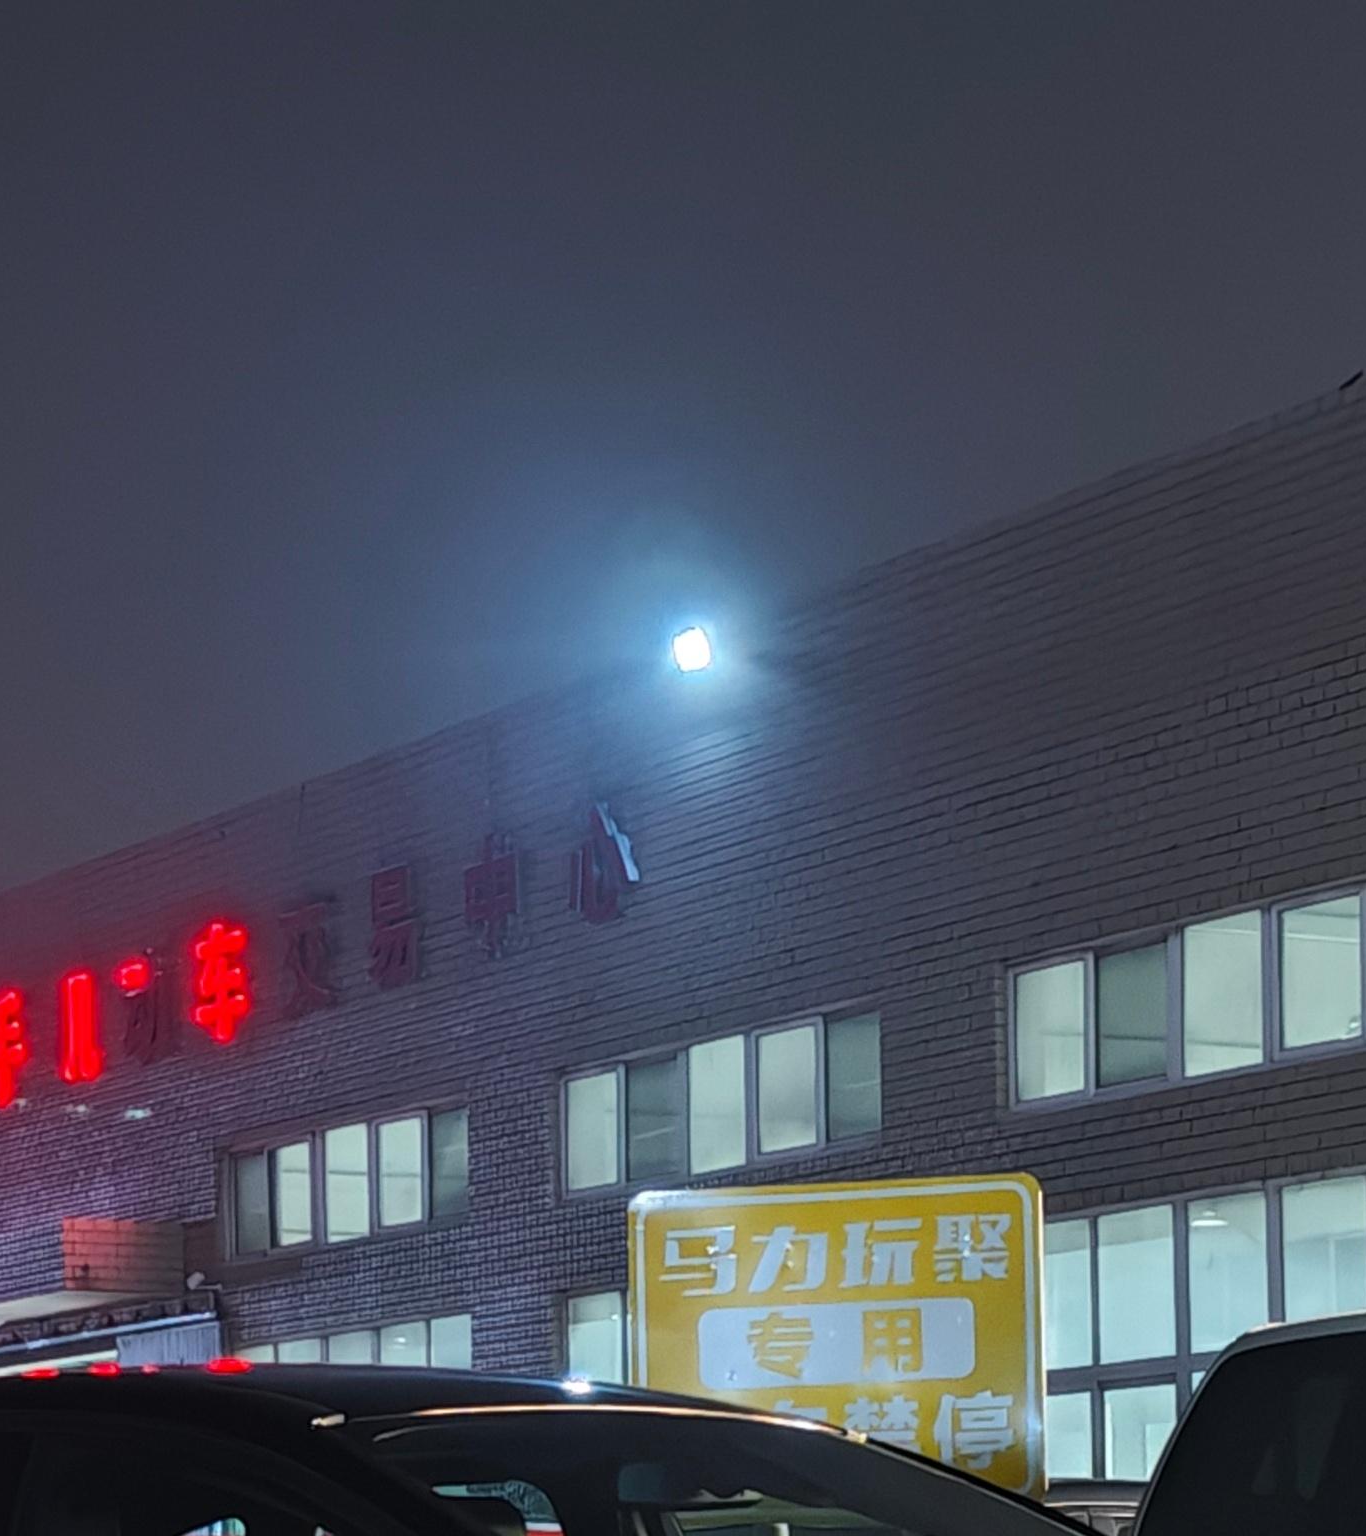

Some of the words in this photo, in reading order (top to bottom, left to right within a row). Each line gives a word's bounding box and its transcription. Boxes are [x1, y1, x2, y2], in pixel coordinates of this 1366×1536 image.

[658, 1212, 1013, 1298] 马力玩聚
[745, 1308, 925, 1380] 专用
[769, 1389, 1014, 1469] 禁停
